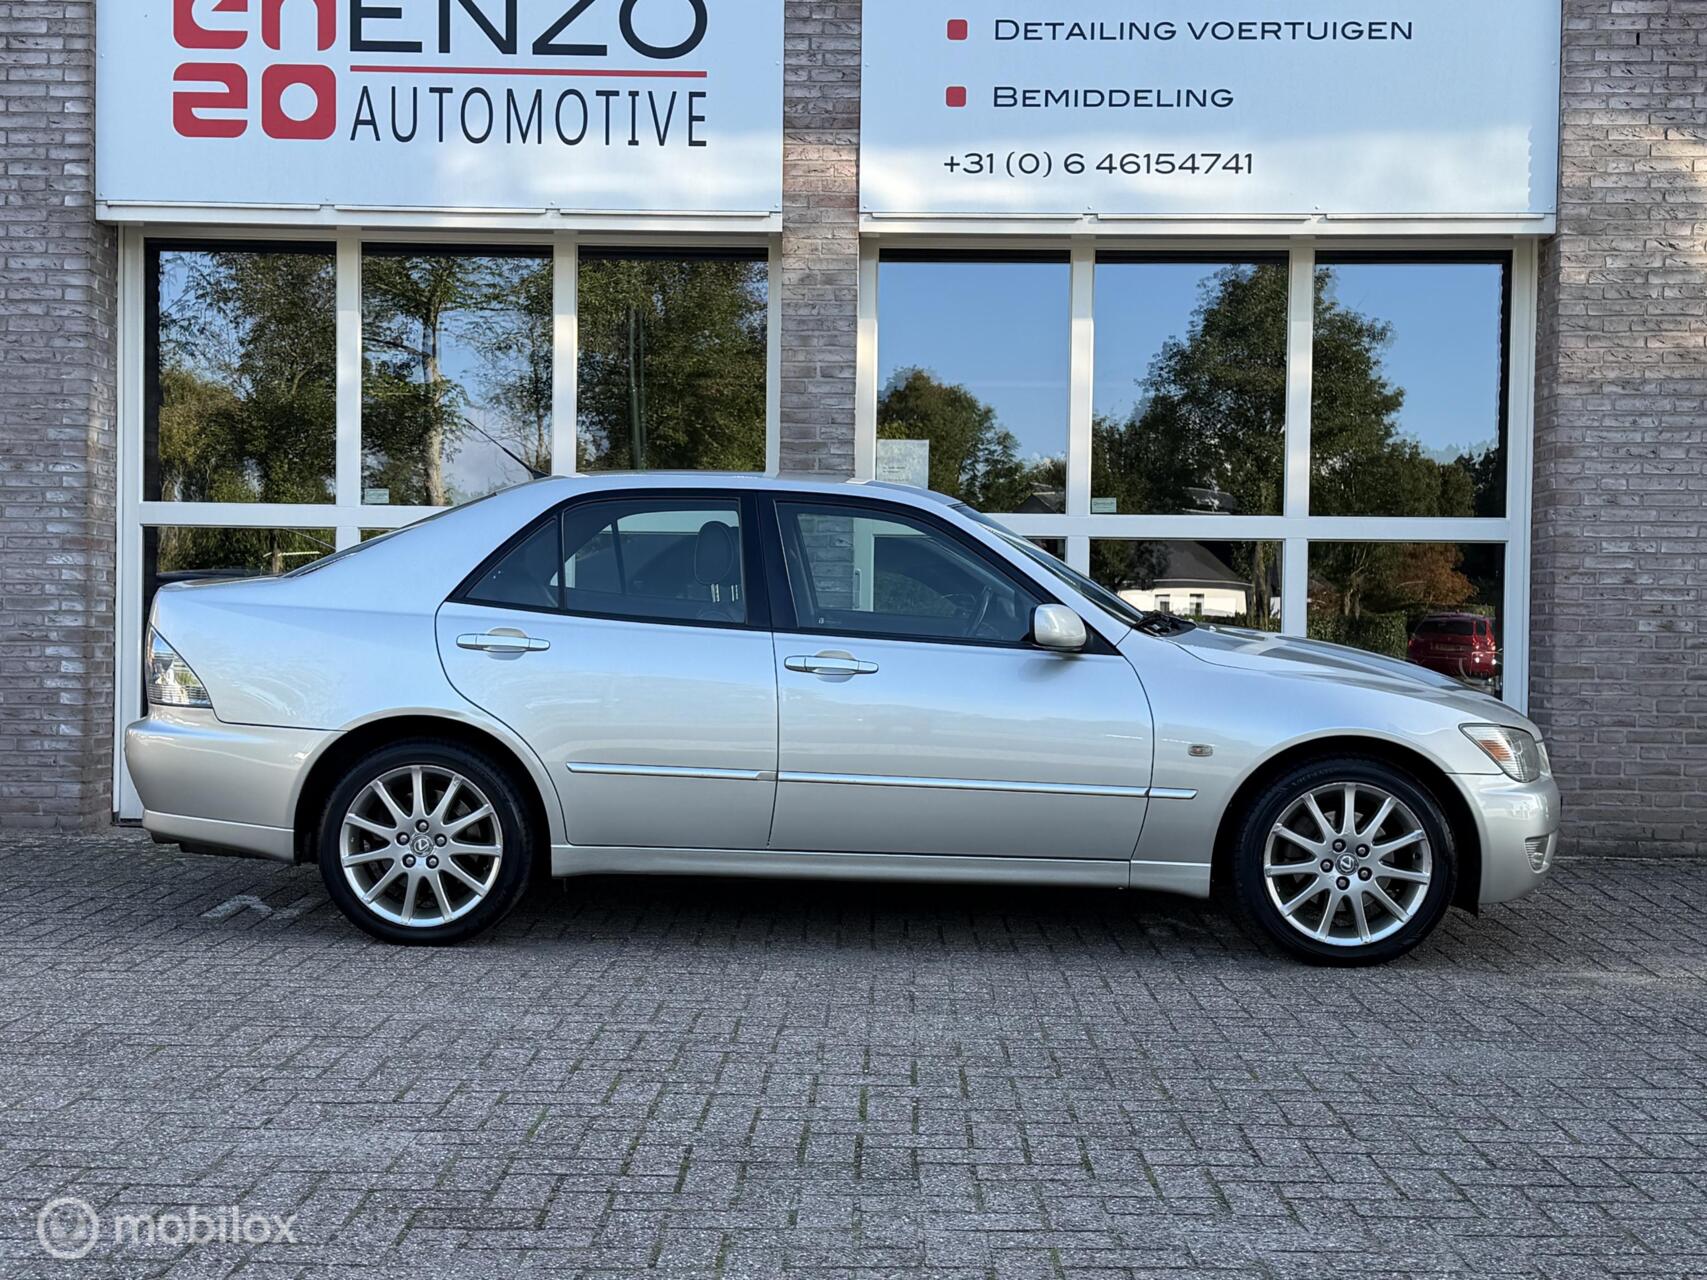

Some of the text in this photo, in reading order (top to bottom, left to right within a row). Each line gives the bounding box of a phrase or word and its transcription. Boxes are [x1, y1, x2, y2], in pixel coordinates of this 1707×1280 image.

[350, 0, 707, 59] ENZO
[994, 19, 1413, 41] DETAILING VOERTUIGEN
[993, 86, 1234, 108] BEMIDDELING
[350, 86, 707, 147] AUTOMOTIVE
[943, 151, 1252, 178] +31 (0) 6 46154741
